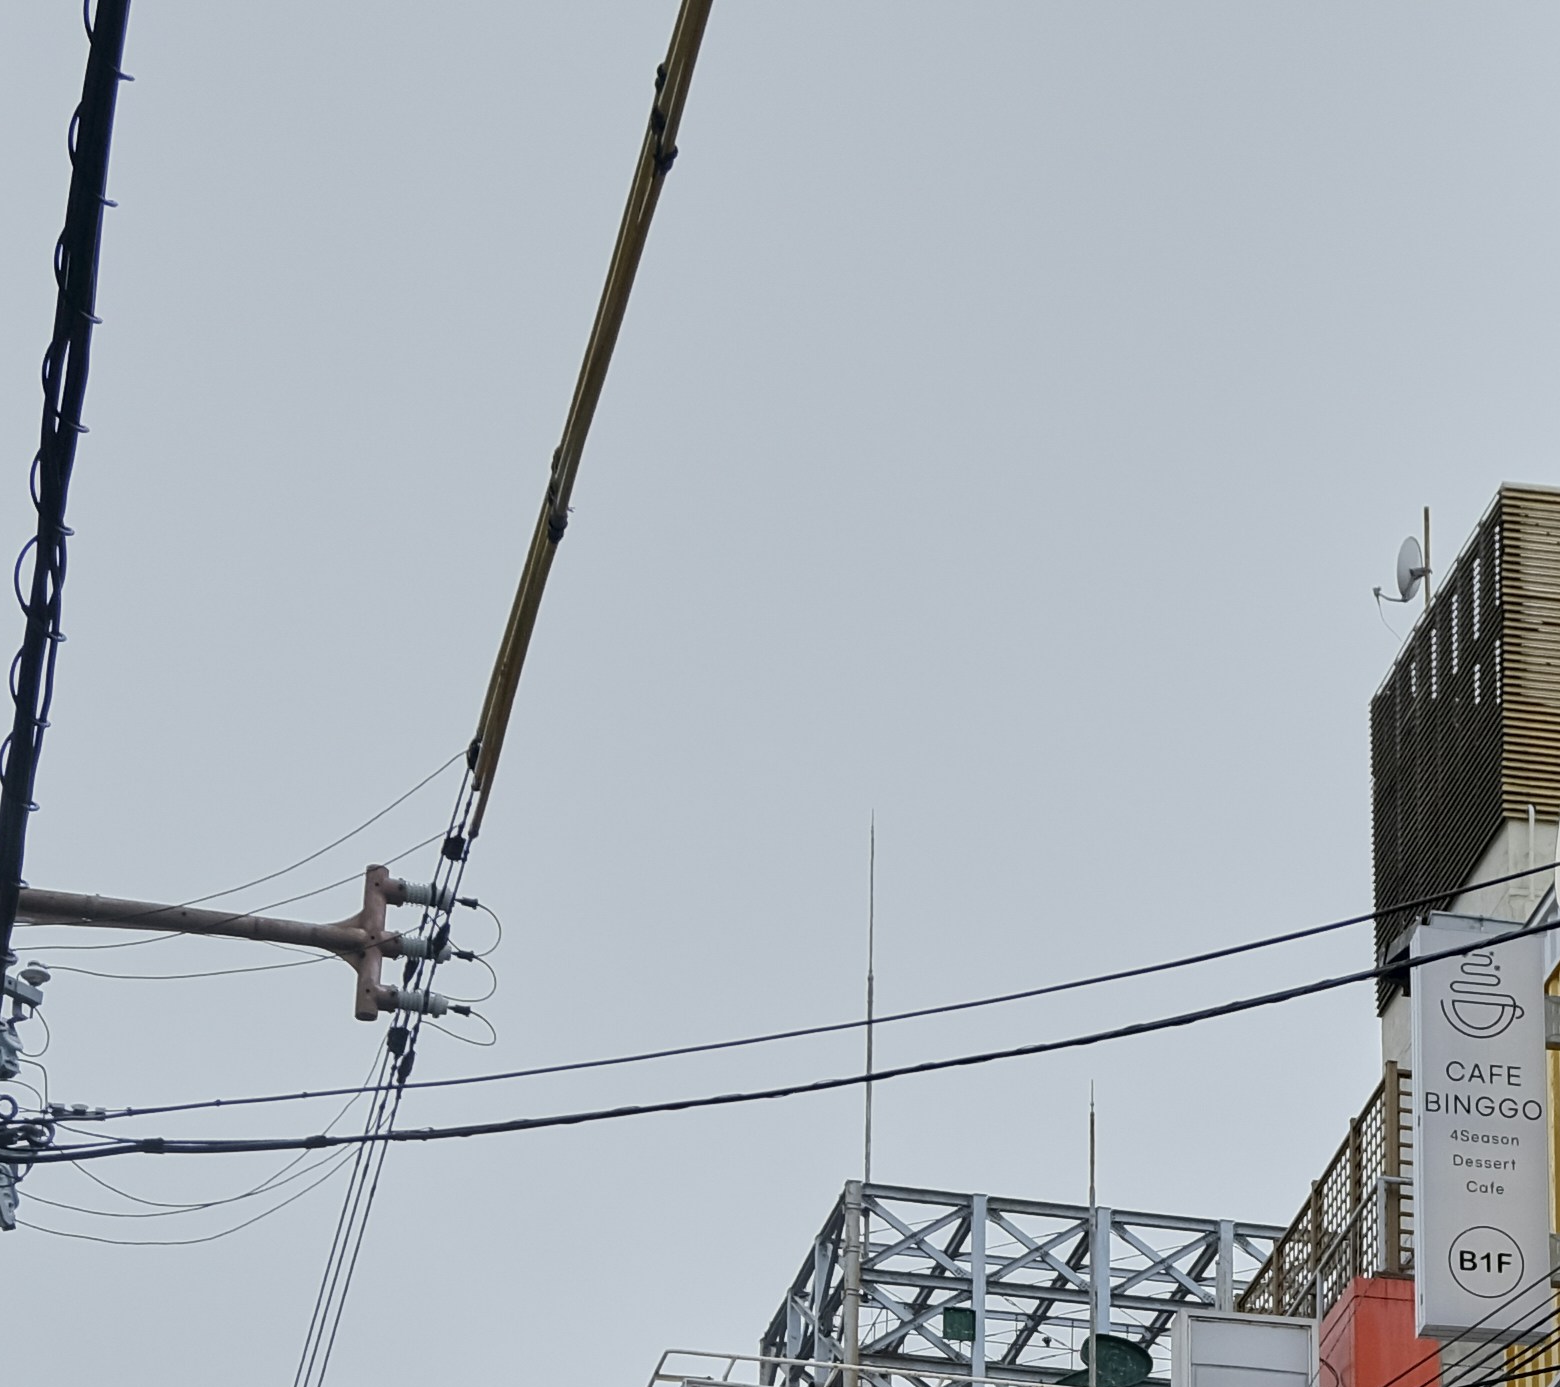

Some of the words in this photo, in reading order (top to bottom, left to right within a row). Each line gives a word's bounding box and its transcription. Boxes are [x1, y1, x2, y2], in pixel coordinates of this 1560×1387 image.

[1446, 1061, 1522, 1086] CAFE
[1425, 1092, 1543, 1121] BINGGO
[1450, 1130, 1520, 1147] 4Season
[1453, 1154, 1517, 1171] Dessert
[1466, 1179, 1505, 1196] Cafe
[1459, 1250, 1513, 1275] B1F
